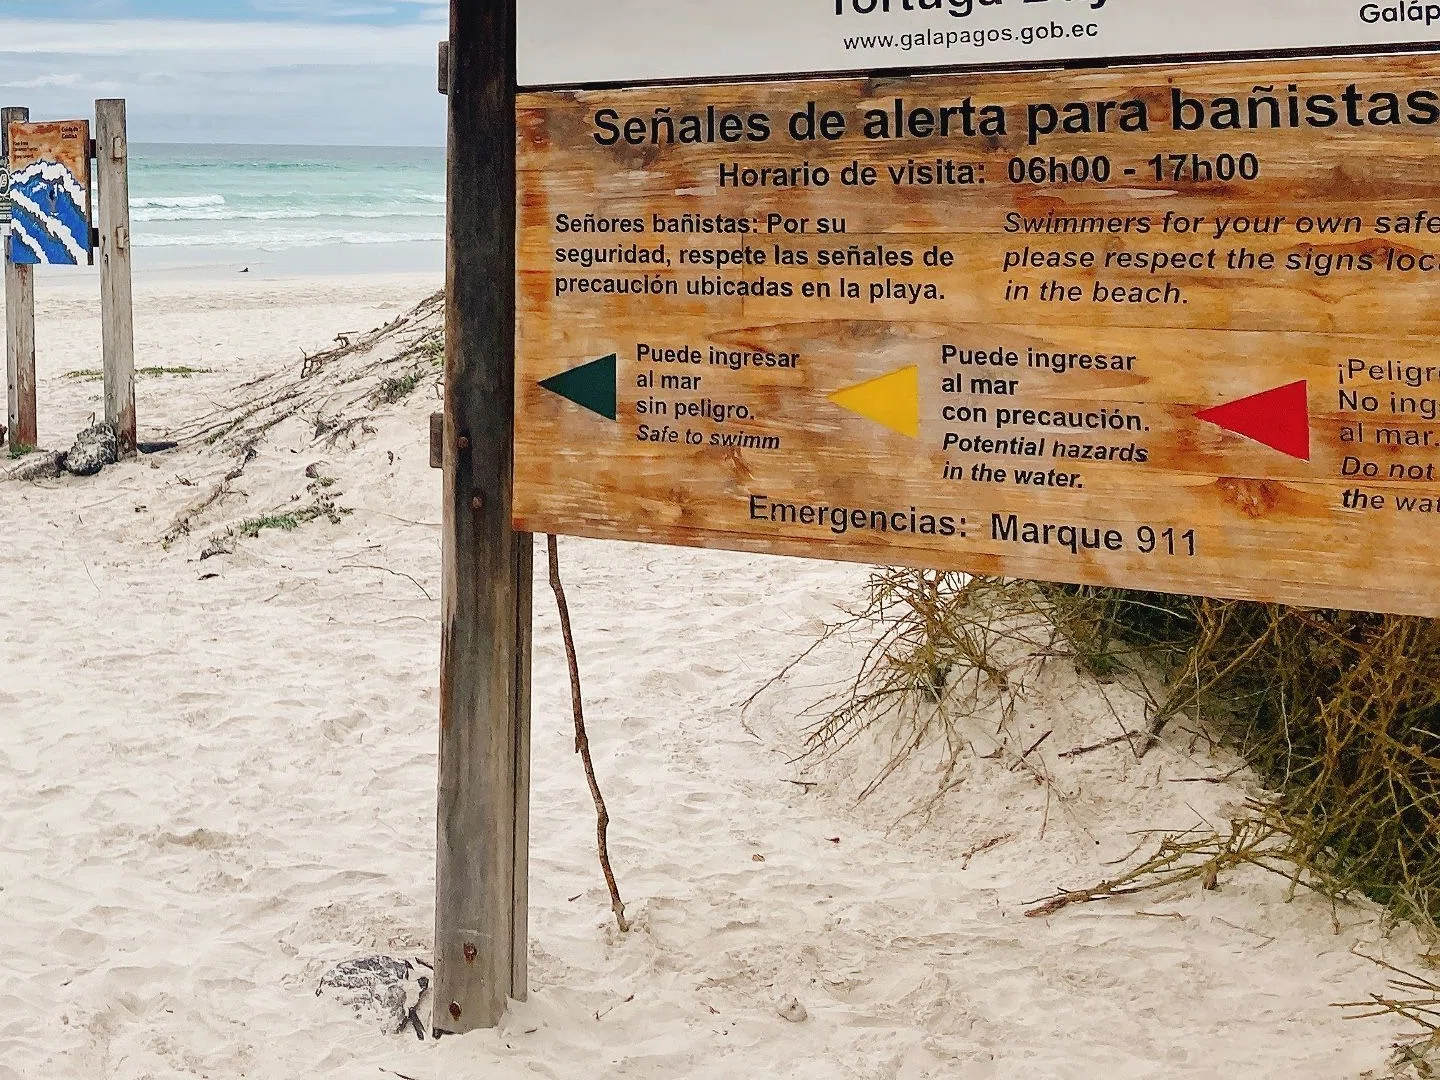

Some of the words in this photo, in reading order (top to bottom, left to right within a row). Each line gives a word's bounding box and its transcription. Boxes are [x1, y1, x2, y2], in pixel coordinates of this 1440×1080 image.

[843, 21, 1098, 51] www.galapagos.gob.ec
[593, 105, 770, 145] Señales
[789, 102, 846, 141] de
[863, 96, 1006, 139] alerta
[1028, 98, 1148, 145] para
[1171, 83, 1439, 130] bañistas
[719, 162, 830, 187] Horario
[840, 161, 877, 185] de
[887, 159, 985, 184] visita:
[1008, 156, 1111, 183] 06h00
[1149, 153, 1259, 181] 17h00
[555, 213, 644, 233] Señores
[653, 213, 758, 233] bañistas:
[767, 214, 808, 233] Por
[816, 218, 846, 233] su
[1004, 212, 1151, 233] Swimmers
[1162, 212, 1203, 233] for
[1212, 216, 1284, 238] your
[1295, 215, 1362, 233] own
[1374, 209, 1440, 233] safe
[555, 245, 671, 266] seguridad,
[679, 247, 766, 266] respete
[774, 246, 809, 266] las
[817, 246, 914, 266] señales
[923, 246, 954, 268] de
[1003, 247, 1095, 272] please
[1104, 250, 1215, 272] respect
[1227, 248, 1275, 270] the
[1286, 248, 1373, 276] signs
[1386, 248, 1440, 271] loc
[555, 274, 677, 296] precaución
[686, 277, 792, 297] ubicadas
[801, 282, 830, 299] en
[840, 278, 860, 299] la
[869, 278, 945, 304] playa.
[1004, 281, 1029, 300] in
[1039, 281, 1082, 302] the
[1092, 283, 1188, 304] beach.
[636, 344, 702, 363] Puede
[709, 346, 800, 369] ingresar
[942, 345, 1019, 366] Puede
[1027, 347, 1136, 373] ingresar
[636, 371, 654, 388] al
[661, 375, 701, 389] mar
[942, 374, 961, 393] al
[970, 378, 1019, 396] mar
[1338, 359, 1440, 387] ¡Peligr
[636, 397, 666, 416] sin
[675, 400, 755, 420] peligro.
[1339, 390, 1379, 411] No
[942, 405, 986, 423] con
[996, 407, 1150, 431] precaución.
[636, 425, 678, 443] Safe
[686, 428, 703, 445] to
[709, 430, 780, 449] swimm
[1340, 423, 1363, 442] al
[1376, 428, 1440, 446] mar.
[943, 433, 1045, 456] Potential
[1053, 441, 1148, 462] hazards
[943, 461, 963, 479] in
[971, 464, 1007, 482] the
[1014, 468, 1083, 489] water.
[1342, 456, 1379, 477] Do
[1389, 463, 1435, 480] not
[1342, 488, 1385, 509] the
[750, 496, 966, 539] Emergencias:
[991, 513, 1122, 553] Marque
[1137, 525, 1197, 556] 911
